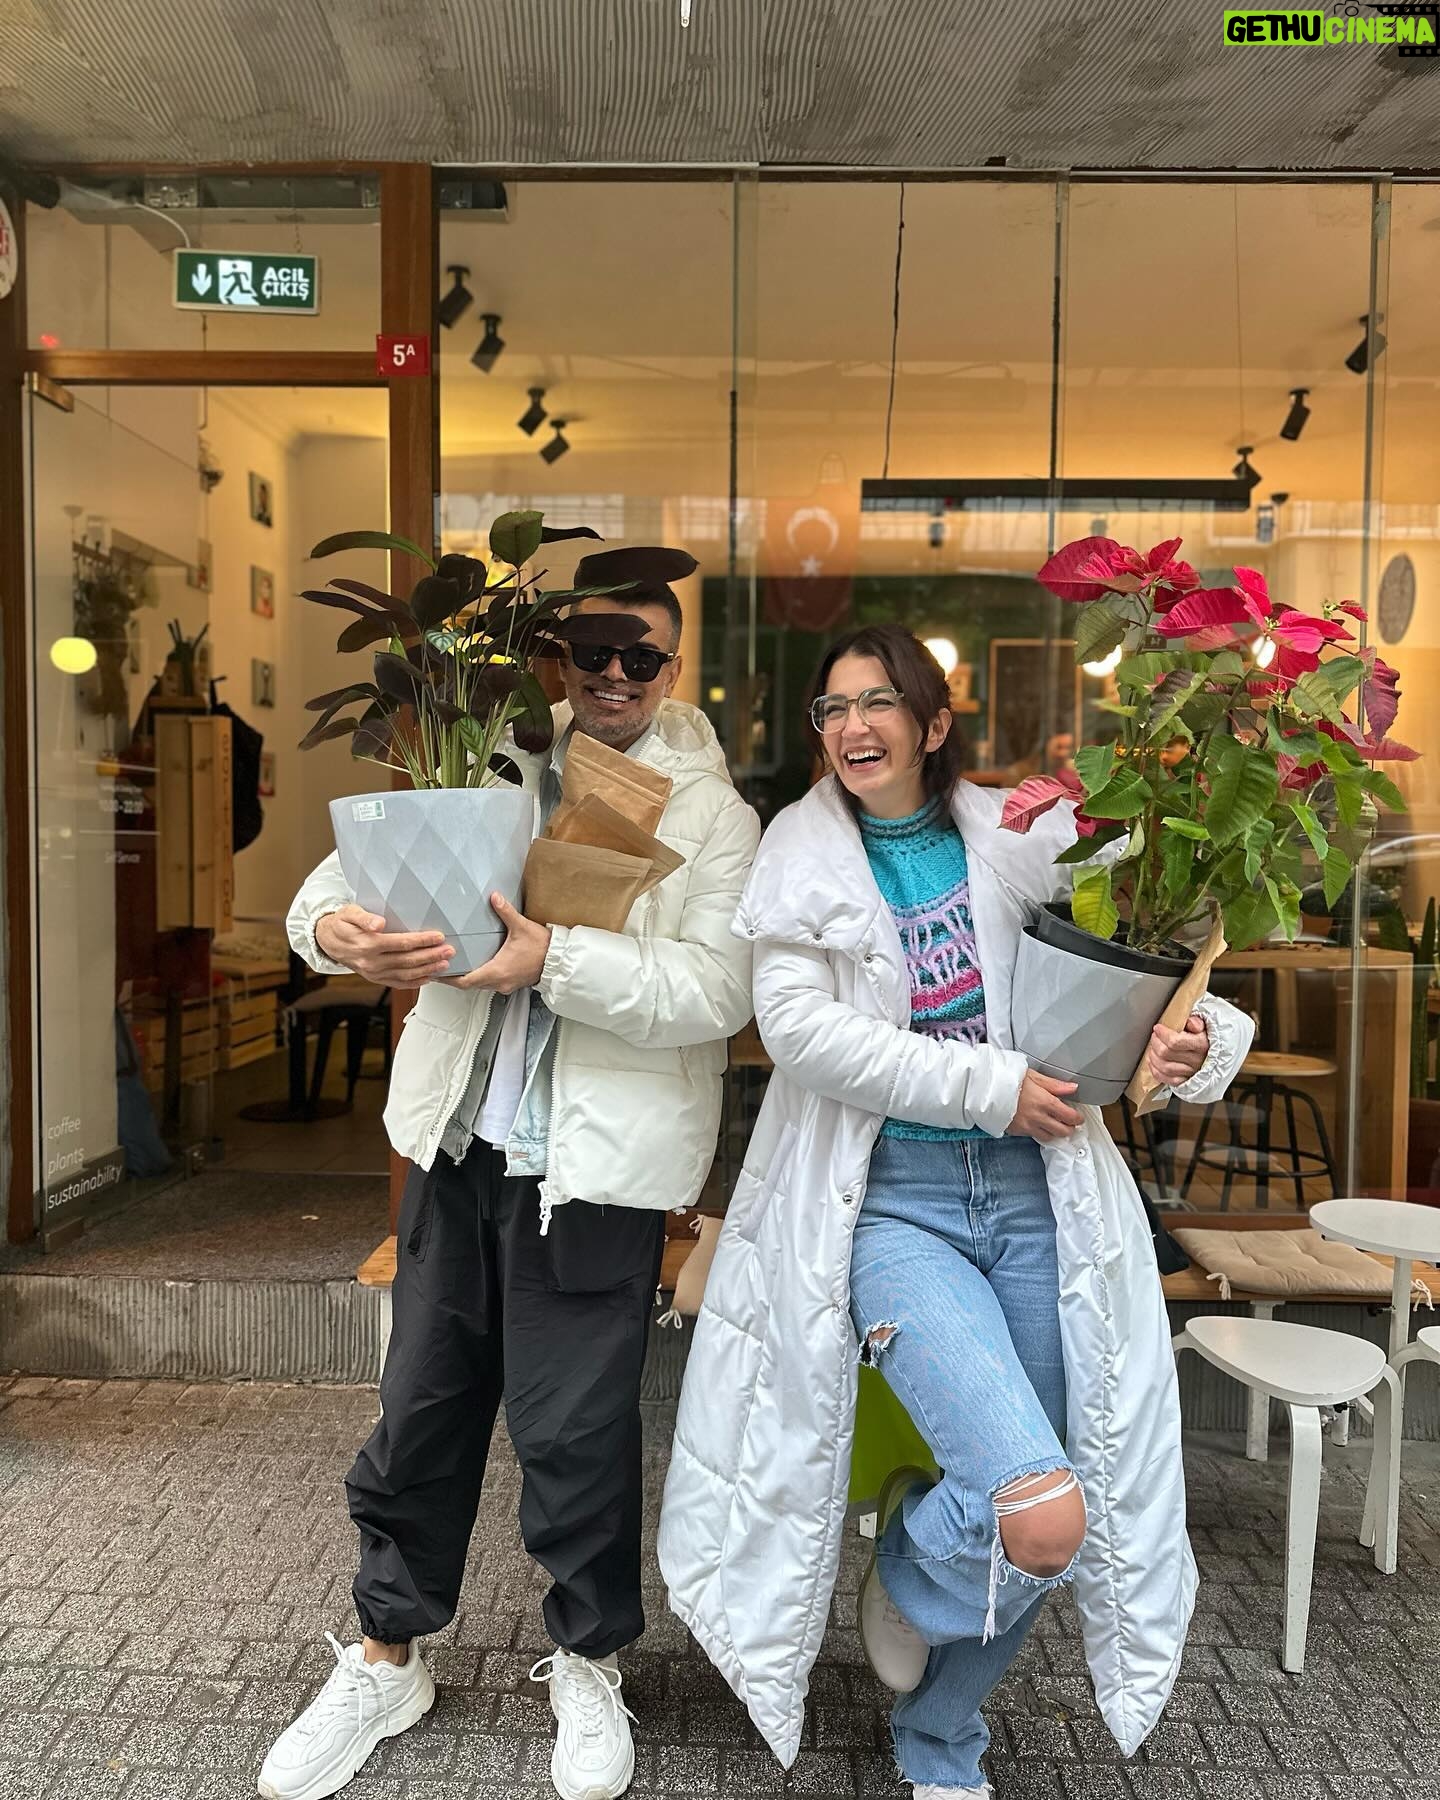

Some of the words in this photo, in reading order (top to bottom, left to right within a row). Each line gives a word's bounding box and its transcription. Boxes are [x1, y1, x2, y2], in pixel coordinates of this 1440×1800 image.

[261, 281, 310, 301] ÇIKIŞ
[48, 1116, 81, 1140] coffee
[48, 1147, 85, 1180] plants
[48, 1164, 123, 1210] sustainability
